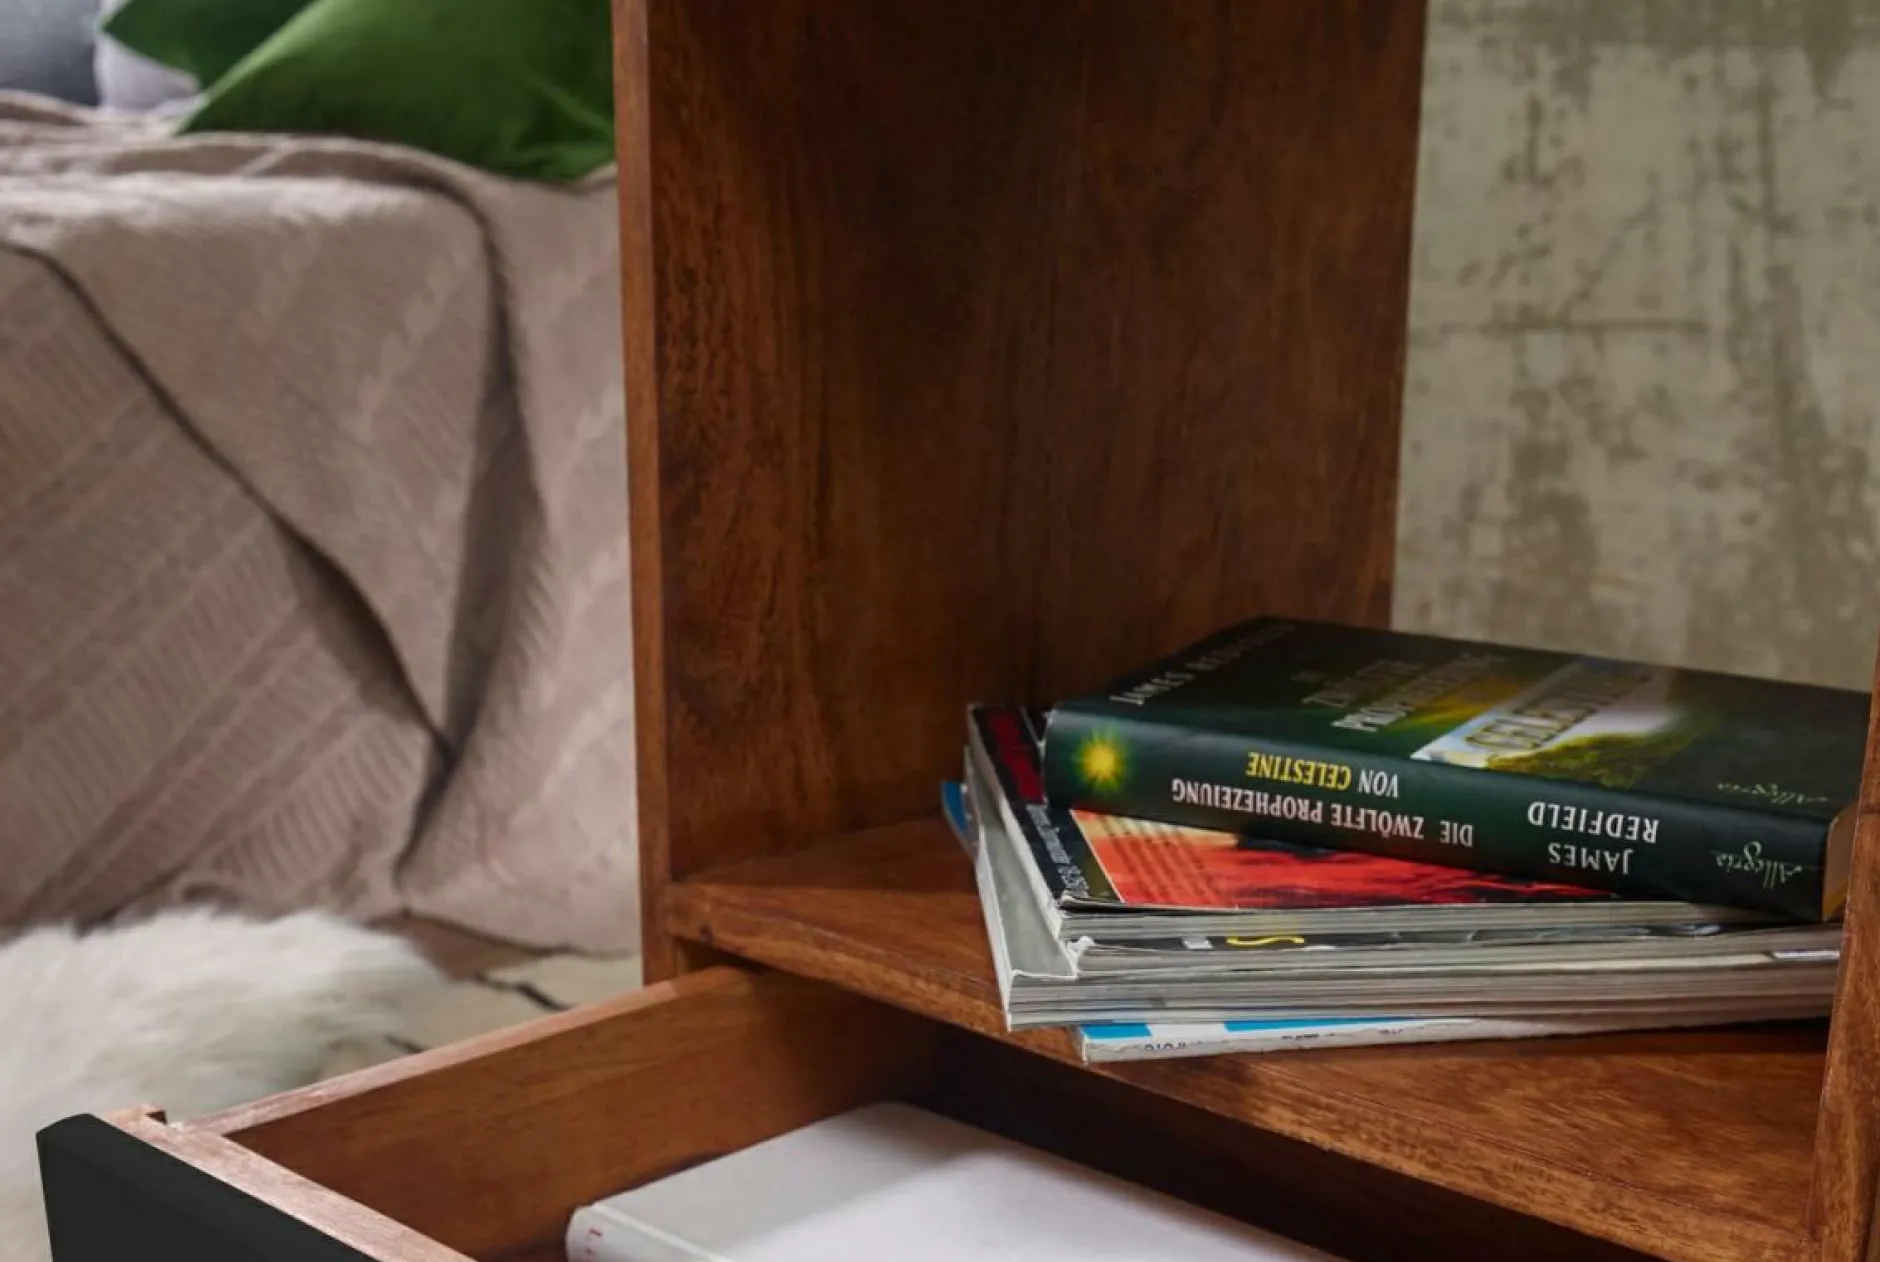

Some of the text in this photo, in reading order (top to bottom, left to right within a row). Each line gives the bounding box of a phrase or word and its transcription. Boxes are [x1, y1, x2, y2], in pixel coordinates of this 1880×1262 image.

[1246, 752, 1399, 798] VON CELESTINE
[1171, 778, 1474, 848] DIE ZWÖLFTE PROPHEZEIUNG
[1527, 800, 1660, 844] REDFIELD
[1548, 842, 1635, 877] JAMES
[1712, 840, 1803, 890] Allegria
